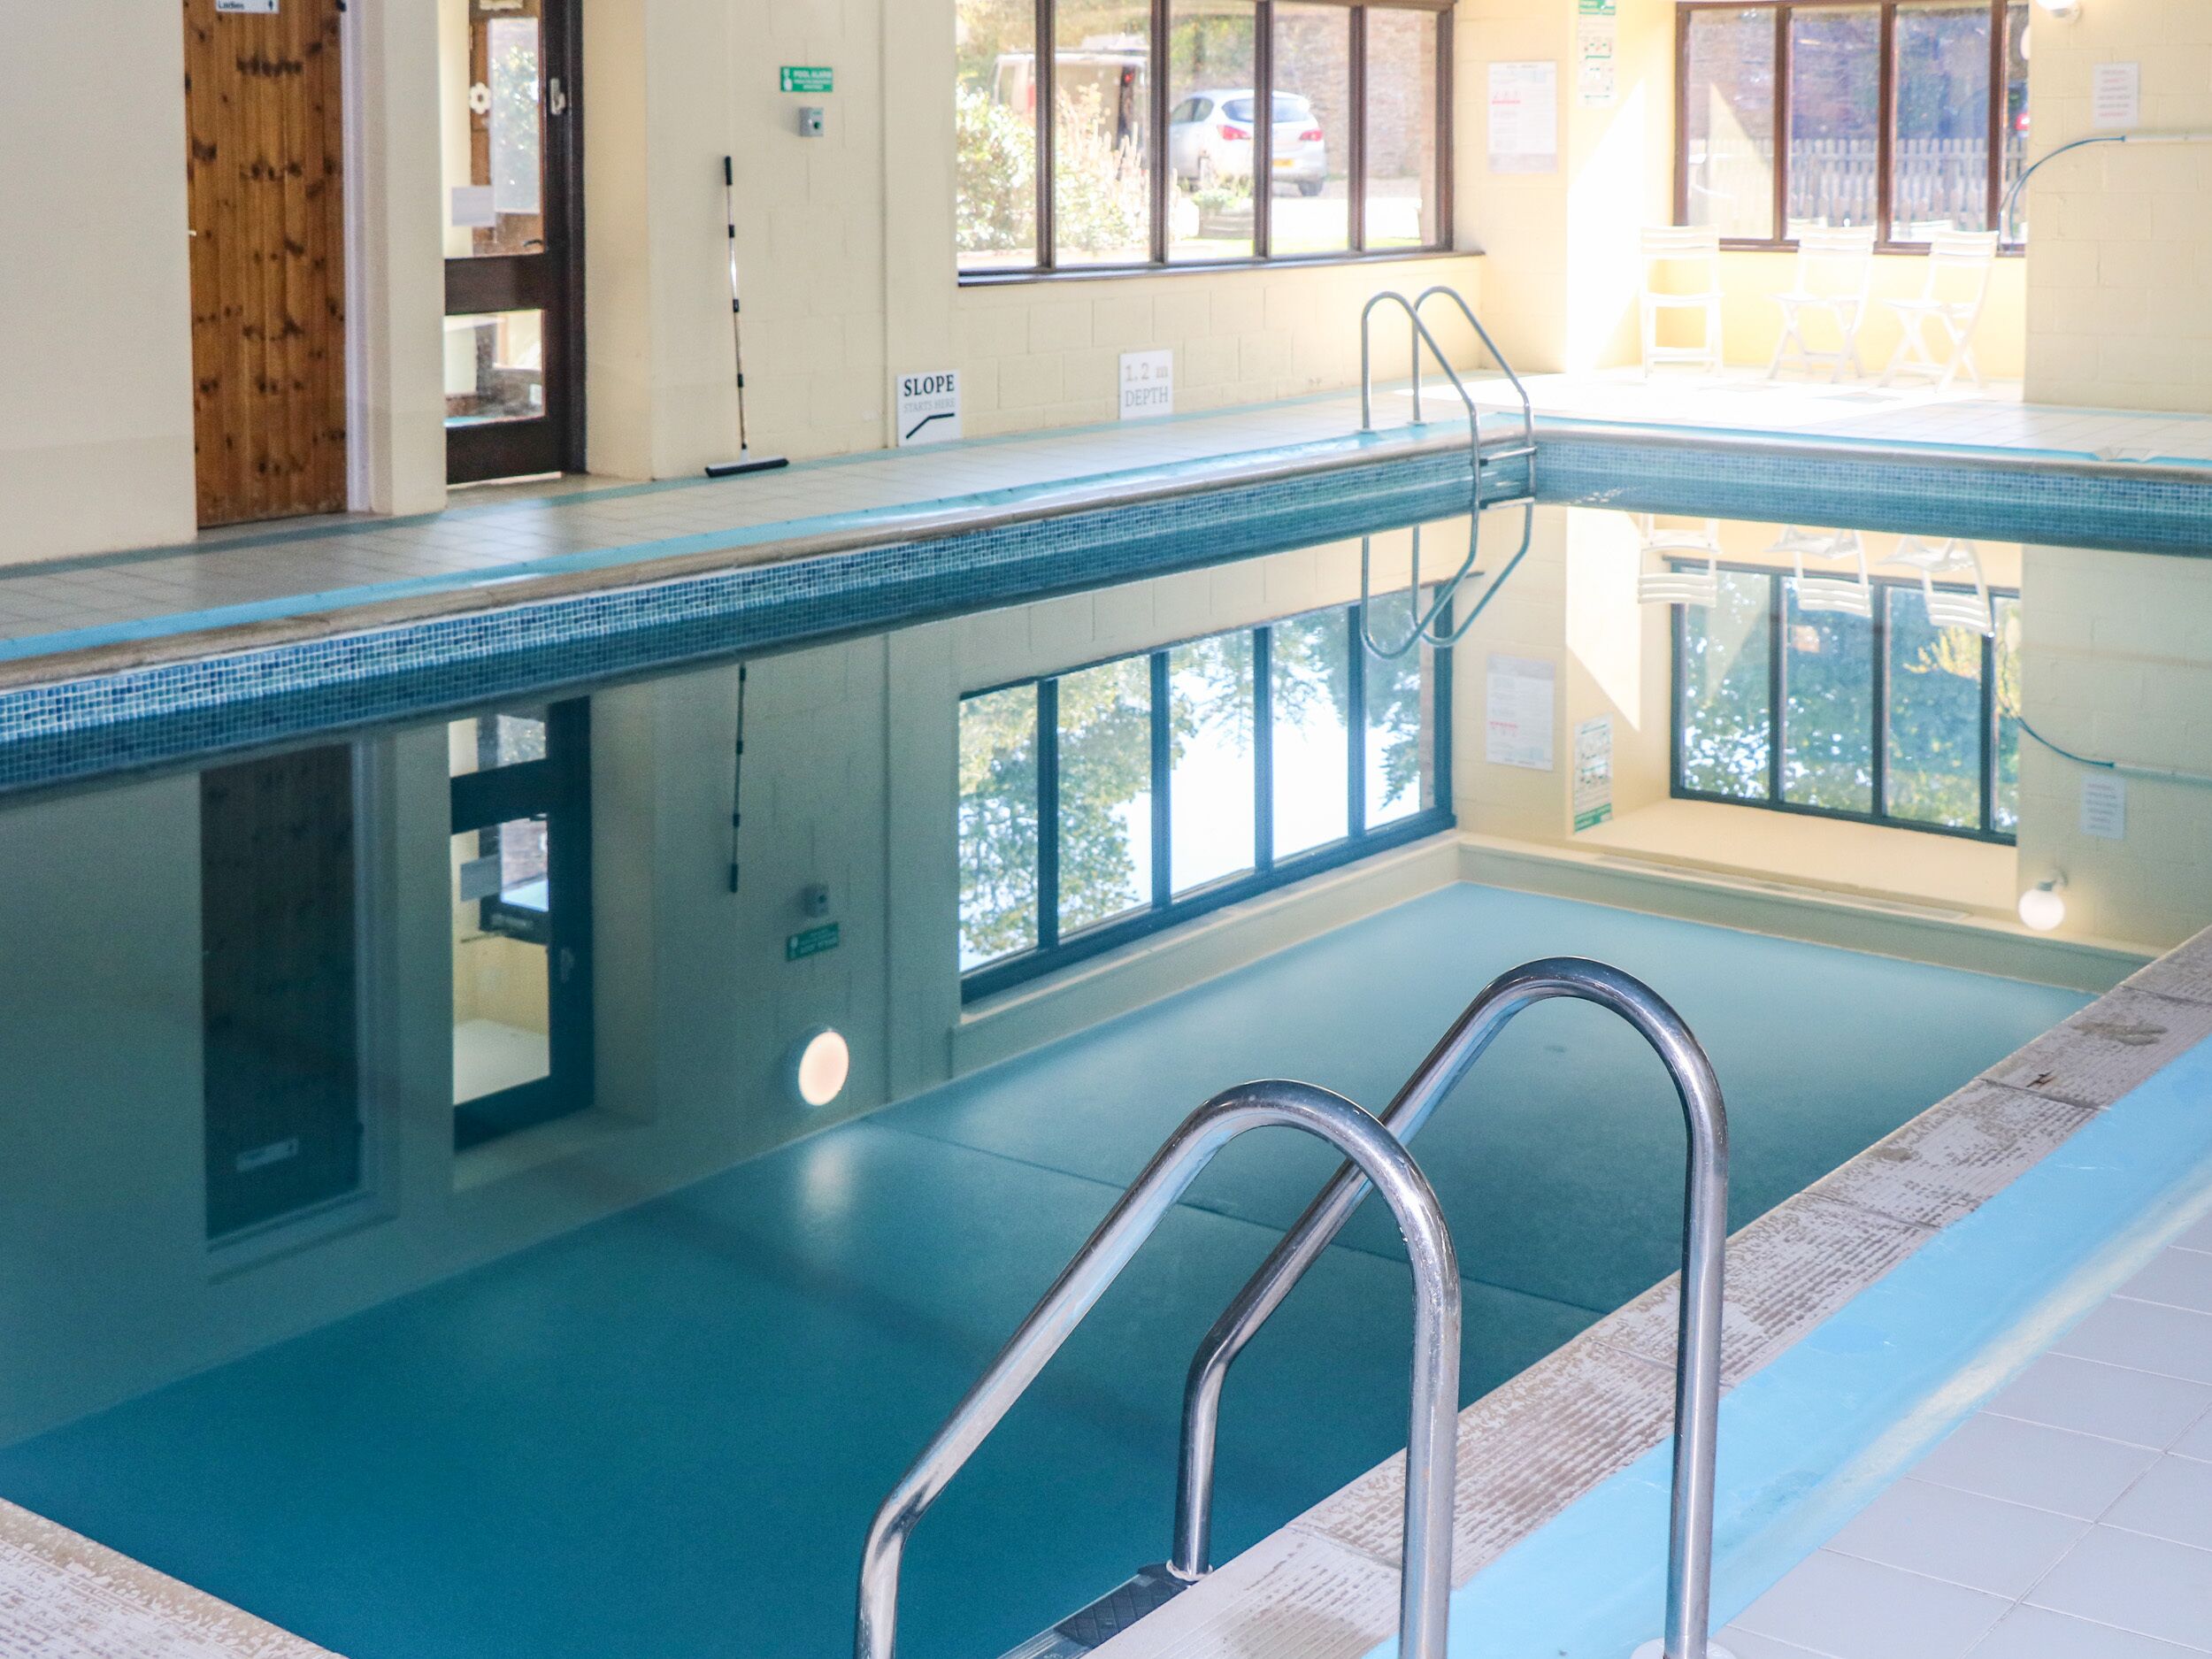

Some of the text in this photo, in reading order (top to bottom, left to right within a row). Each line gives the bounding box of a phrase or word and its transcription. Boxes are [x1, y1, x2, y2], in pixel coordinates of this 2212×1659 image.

[903, 374, 955, 396] SLOPE
[904, 397, 955, 412] STARTS HERE
[1125, 386, 1169, 407] DEPTH
